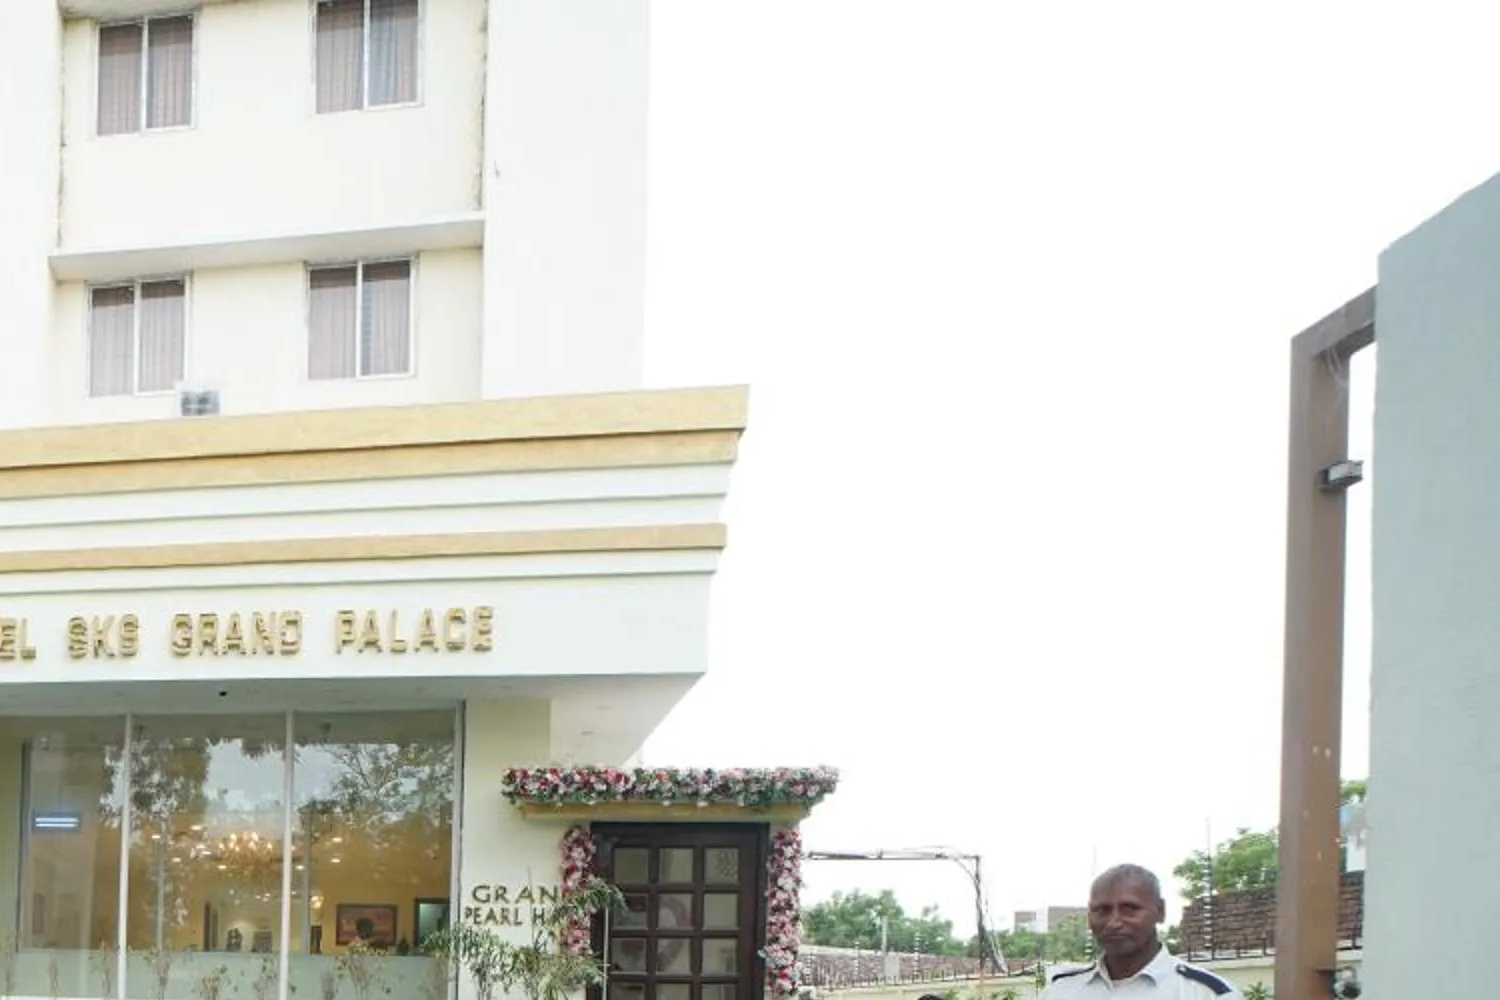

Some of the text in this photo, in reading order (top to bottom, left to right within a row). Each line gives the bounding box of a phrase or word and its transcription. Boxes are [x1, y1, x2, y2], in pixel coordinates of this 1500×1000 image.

[67, 613, 140, 660] SKS
[170, 609, 303, 657] GRAND
[334, 605, 494, 655] PALACE
[463, 905, 523, 926] PEARL
